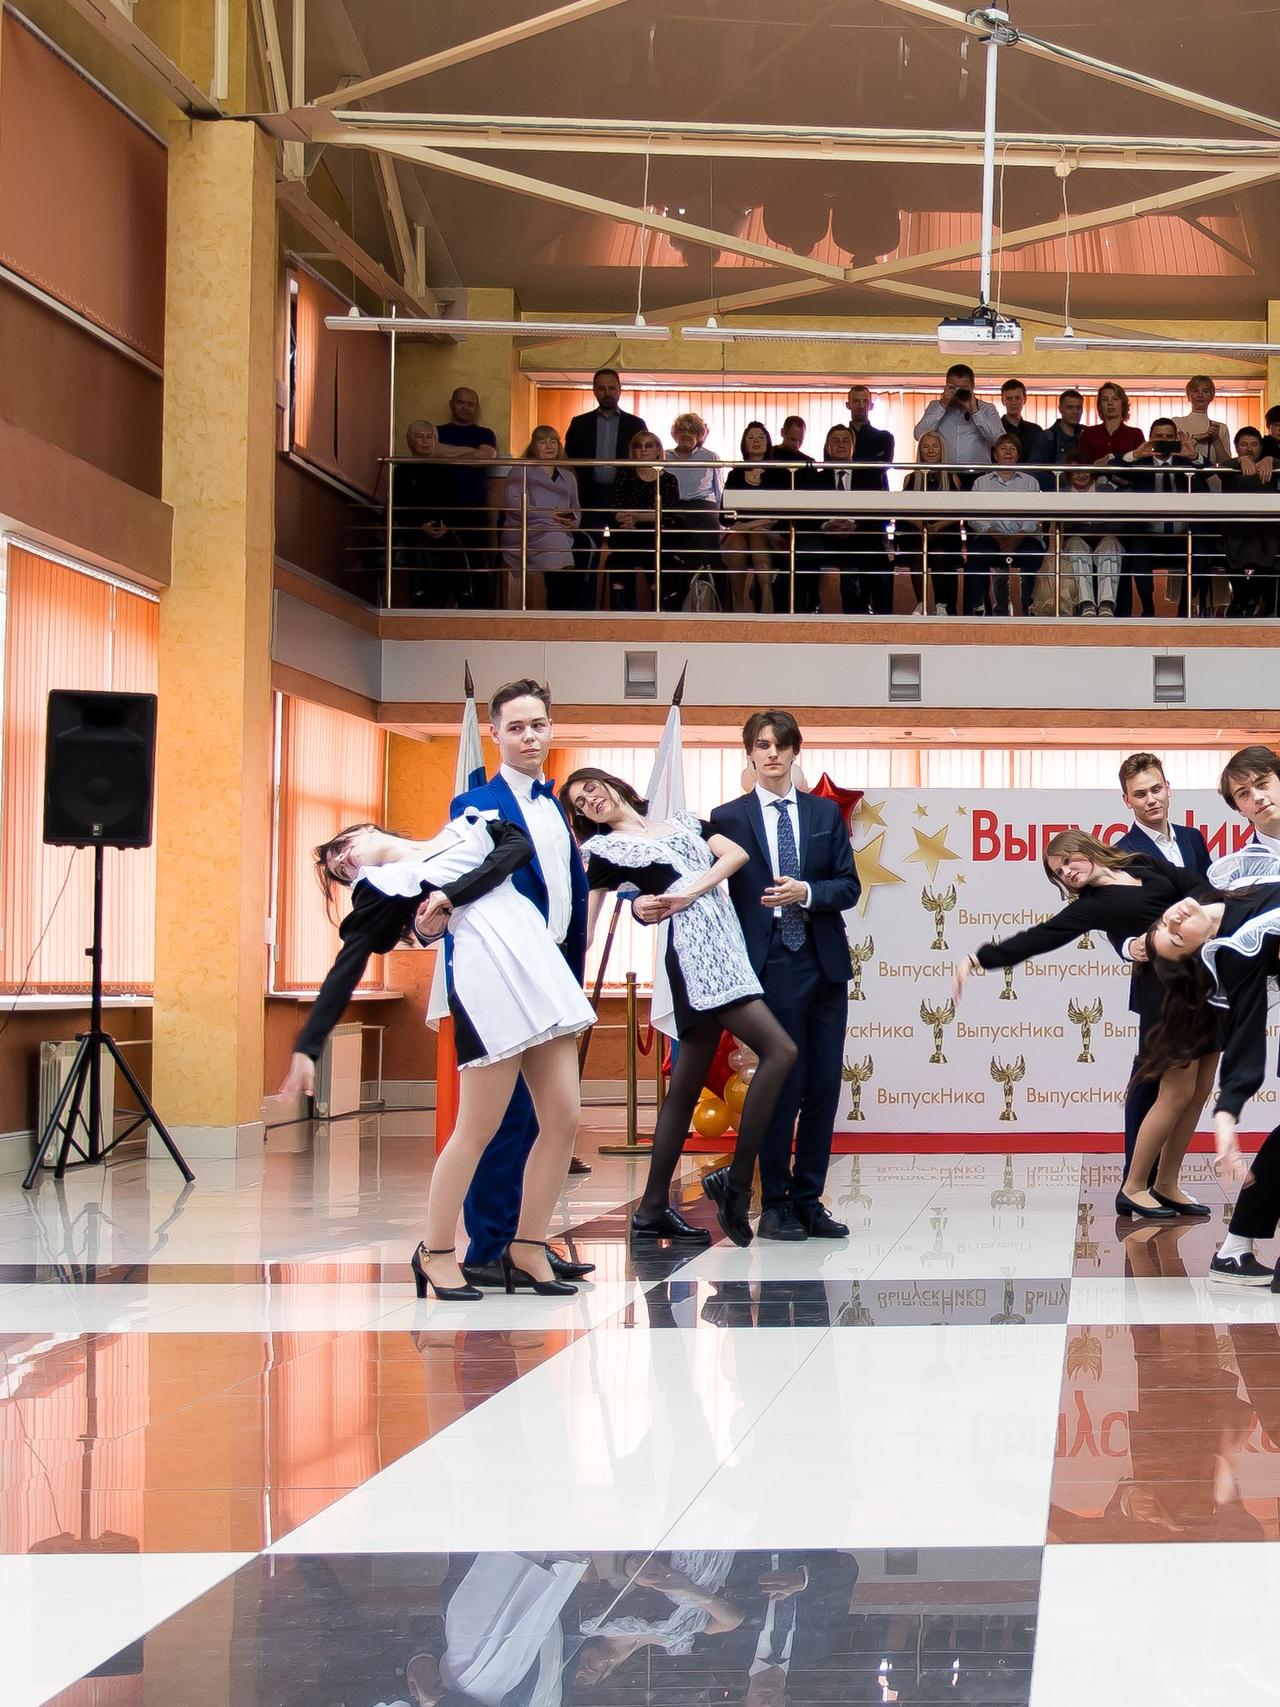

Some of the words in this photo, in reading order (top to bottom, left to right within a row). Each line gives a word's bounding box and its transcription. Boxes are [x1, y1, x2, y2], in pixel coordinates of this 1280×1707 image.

[958, 909, 1054, 931] ВыпускНик
[878, 961, 986, 982] ВыпускНка
[1025, 960, 1132, 981] ВыпускНика
[956, 1022, 1064, 1043] ВыпускНика
[877, 1088, 986, 1109] ВыпускНика
